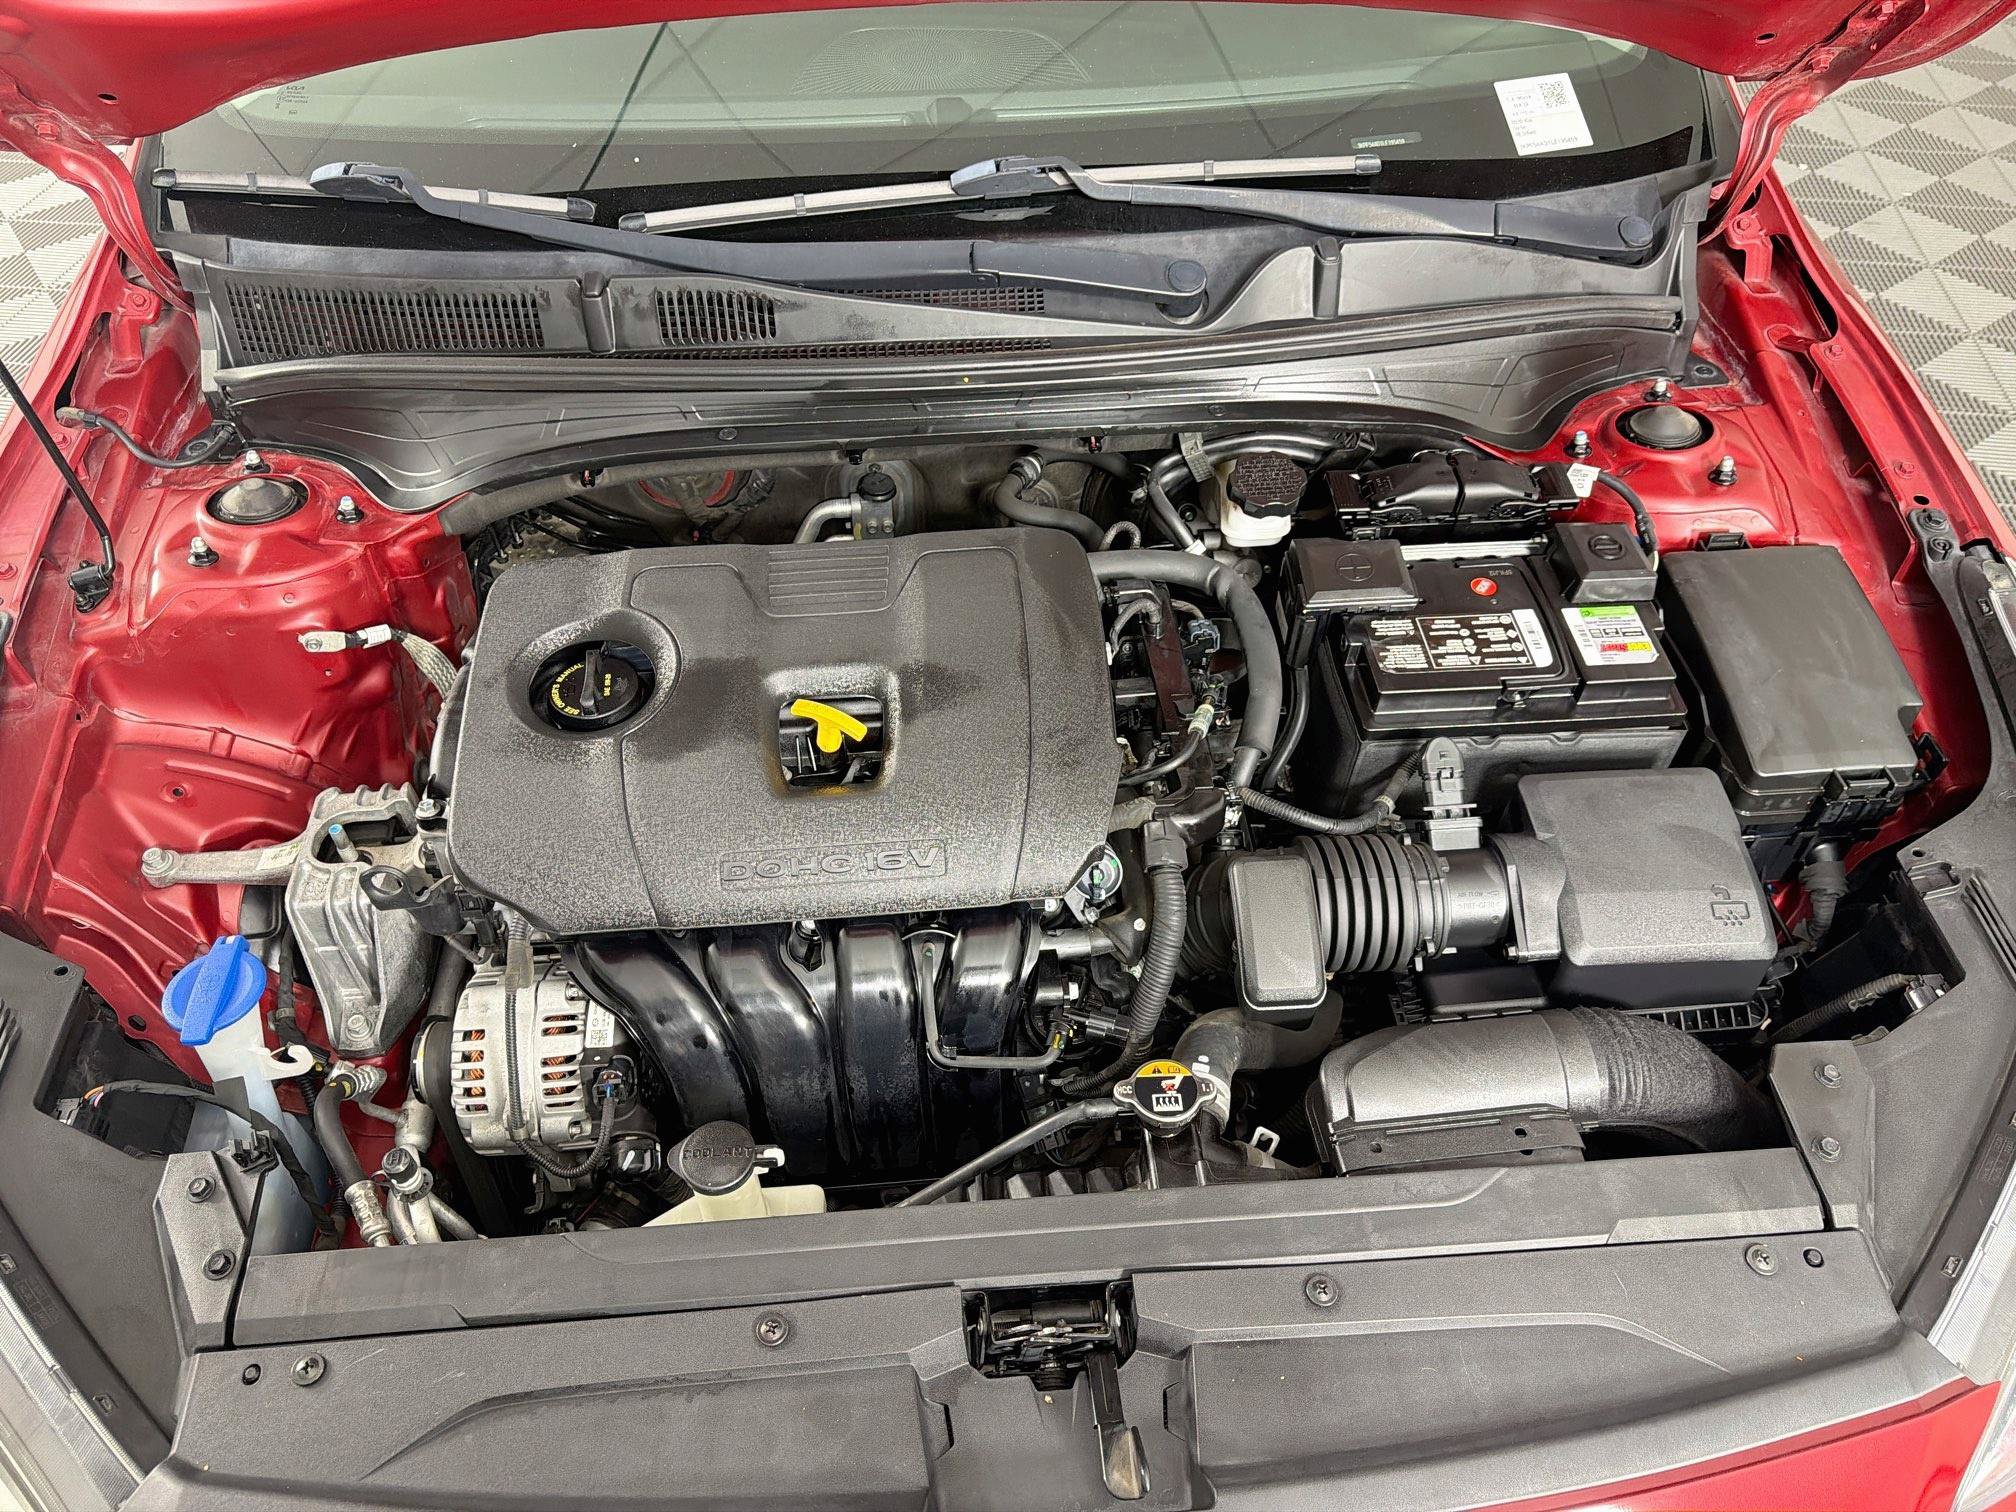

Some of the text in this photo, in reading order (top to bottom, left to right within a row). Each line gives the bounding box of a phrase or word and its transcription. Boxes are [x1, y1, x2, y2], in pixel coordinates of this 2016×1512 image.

[551, 663, 585, 715] SEE OWNER'S MANUAL
[720, 847, 941, 881] DOHC 16V
[1116, 1083, 1213, 1094] HCC 1.1
[682, 1146, 754, 1159] COOLANT
